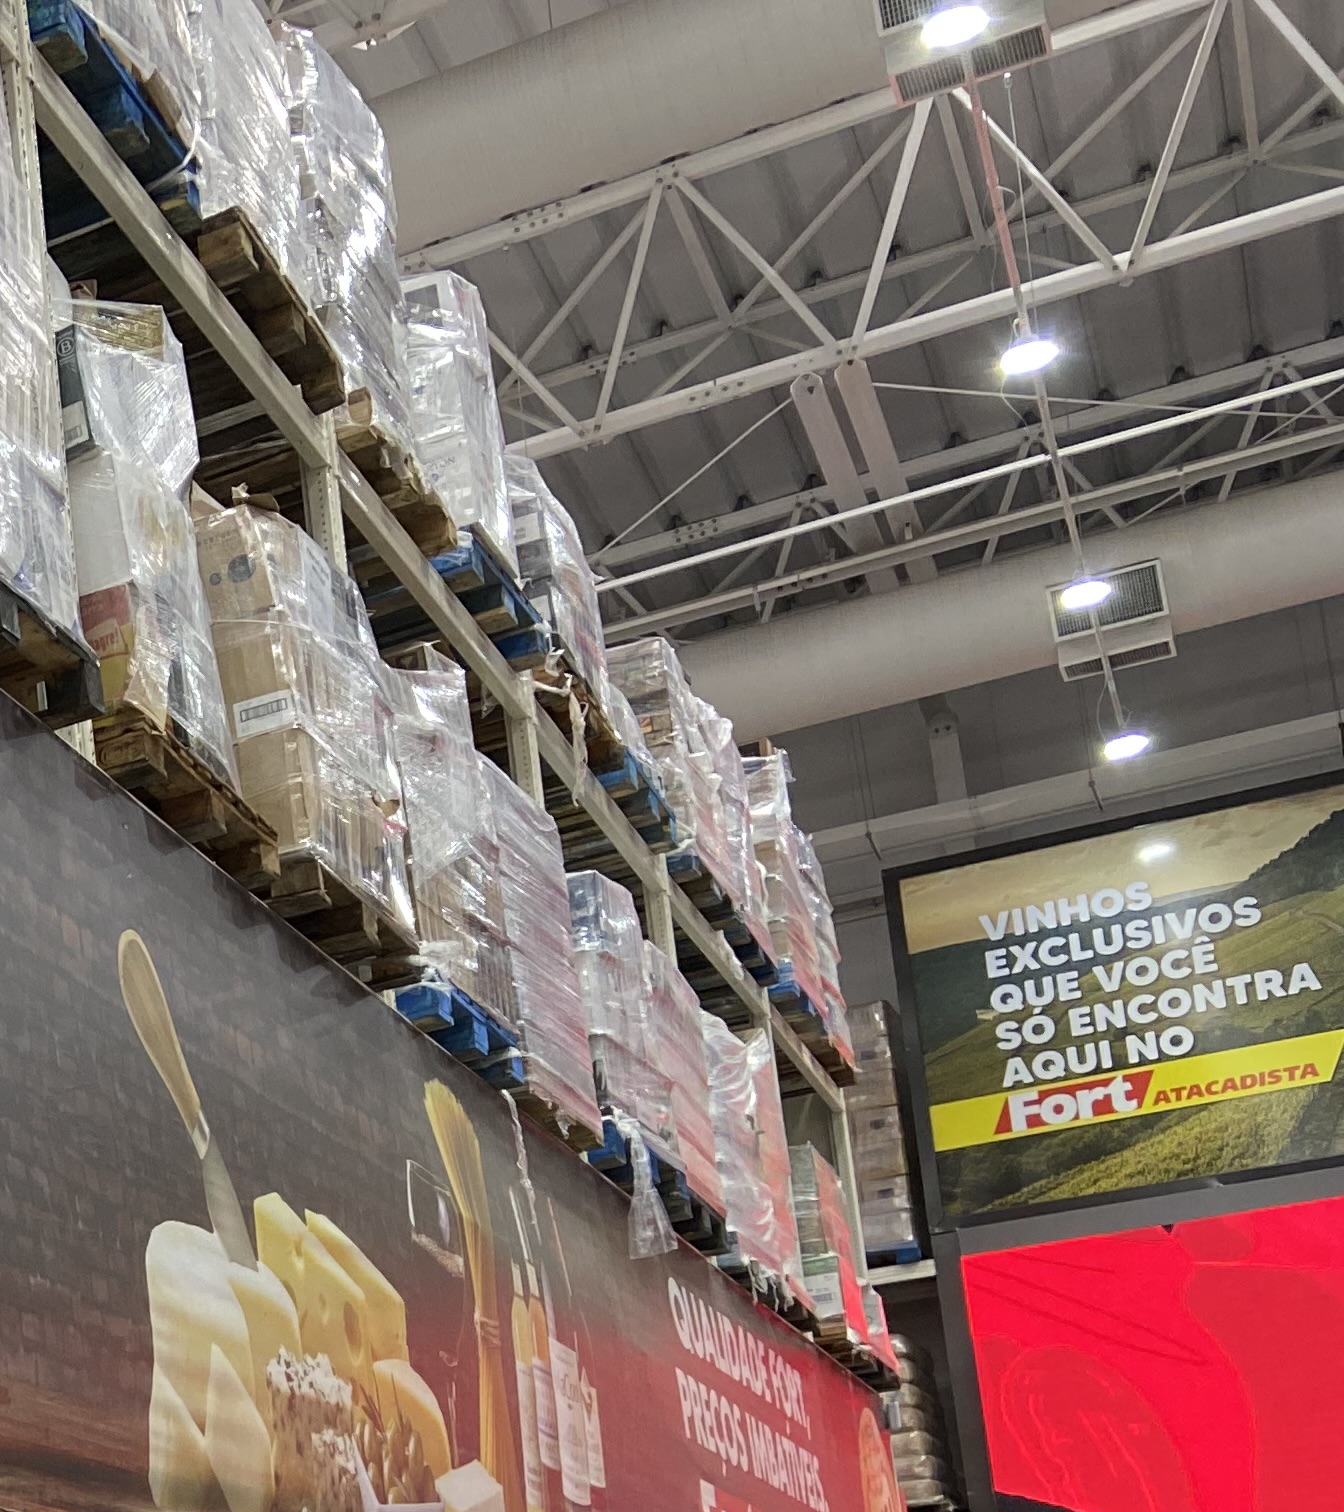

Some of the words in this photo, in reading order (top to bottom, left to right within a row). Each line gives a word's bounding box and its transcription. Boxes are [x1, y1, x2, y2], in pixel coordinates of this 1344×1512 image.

[979, 882, 1152, 941] VINHOS
[984, 897, 1262, 979] EXCLUSIVOS
[991, 971, 1081, 1013] QUE
[1093, 937, 1219, 994] VOCÊ
[996, 1007, 1055, 1050] SÓ
[1069, 963, 1323, 1037] ENCONTRA
[1003, 1042, 1112, 1087] AQUI
[1126, 1027, 1195, 1064] NO
[1008, 1076, 1138, 1132] Fort
[1153, 1063, 1320, 1106] ATACADISTA
[668, 1277, 772, 1404] QUALIDADE
[675, 1367, 748, 1477] PREÇOS
